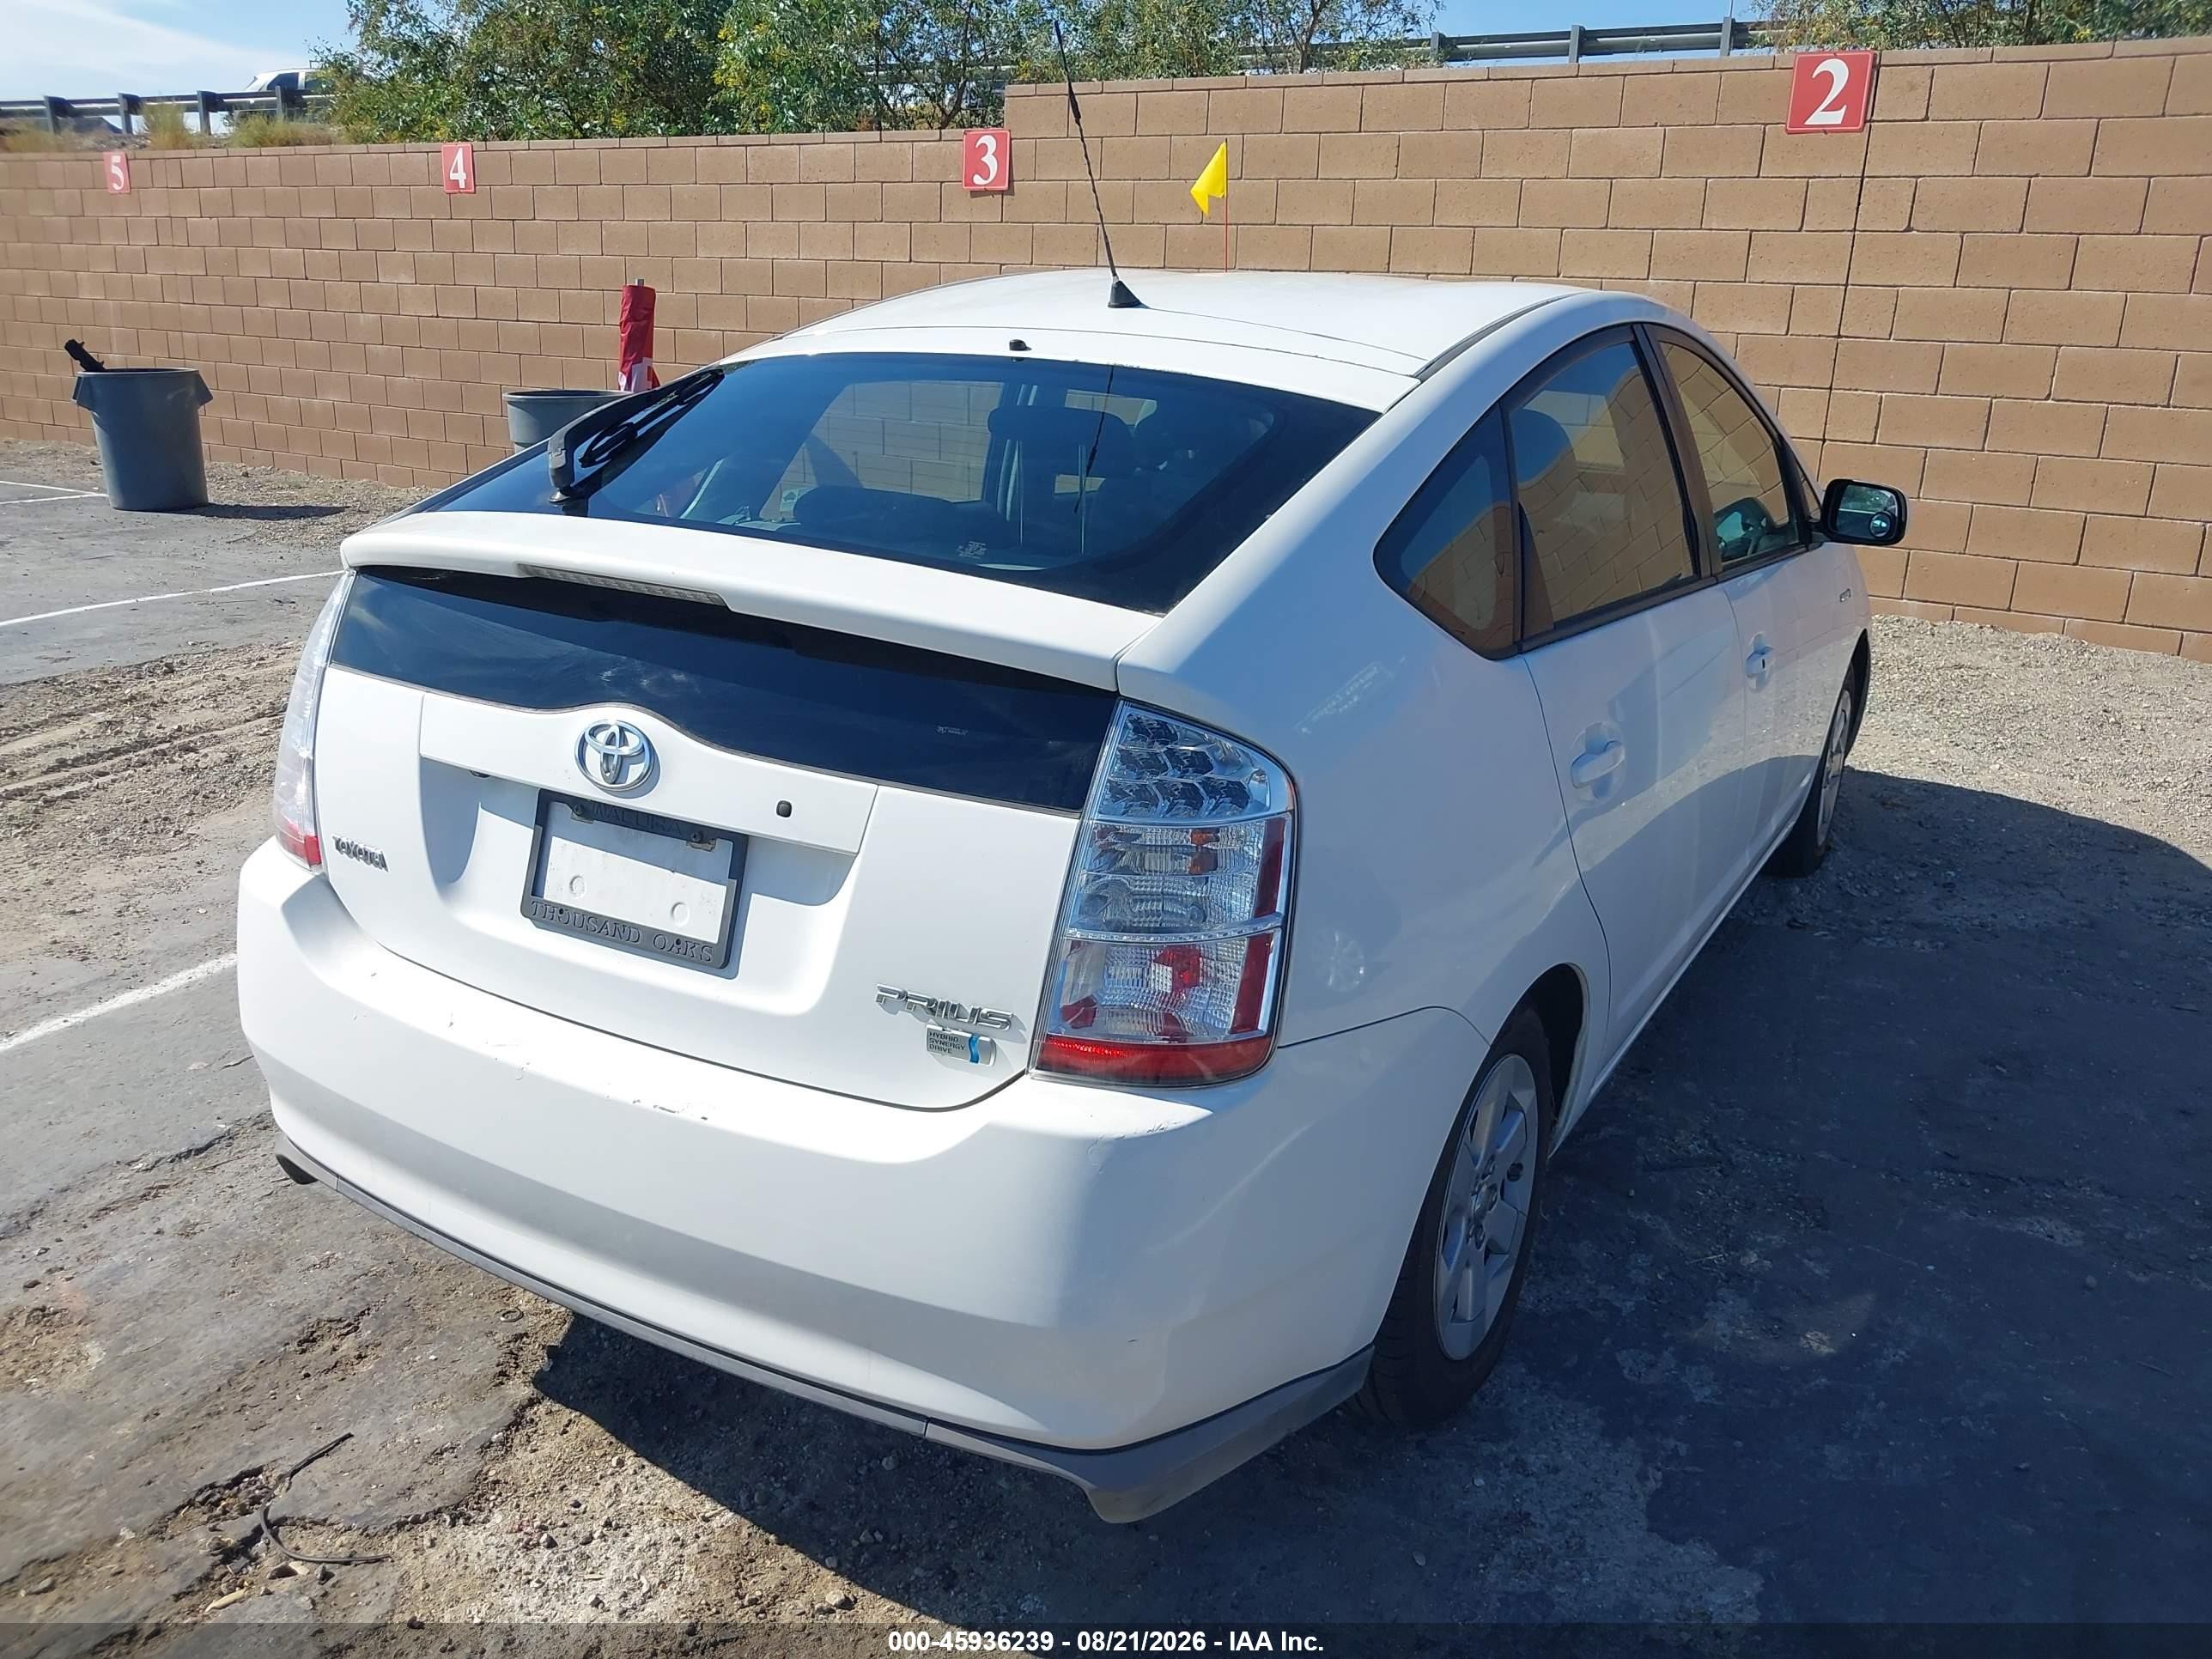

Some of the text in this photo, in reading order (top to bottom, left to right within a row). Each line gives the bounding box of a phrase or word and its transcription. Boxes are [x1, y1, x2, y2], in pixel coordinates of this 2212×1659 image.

[1803, 58, 1849, 125] 2
[111, 155, 125, 191] 5
[449, 147, 467, 189] 4
[972, 134, 998, 185] 3
[331, 836, 389, 872] TOYOTA
[530, 900, 714, 962] THOUSAND OAKS
[875, 982, 1014, 1030] PRIUS
[929, 1031, 959, 1042] HYBRID
[929, 1037, 965, 1050] SYNERGY
[929, 1044, 953, 1054] DRIVE
